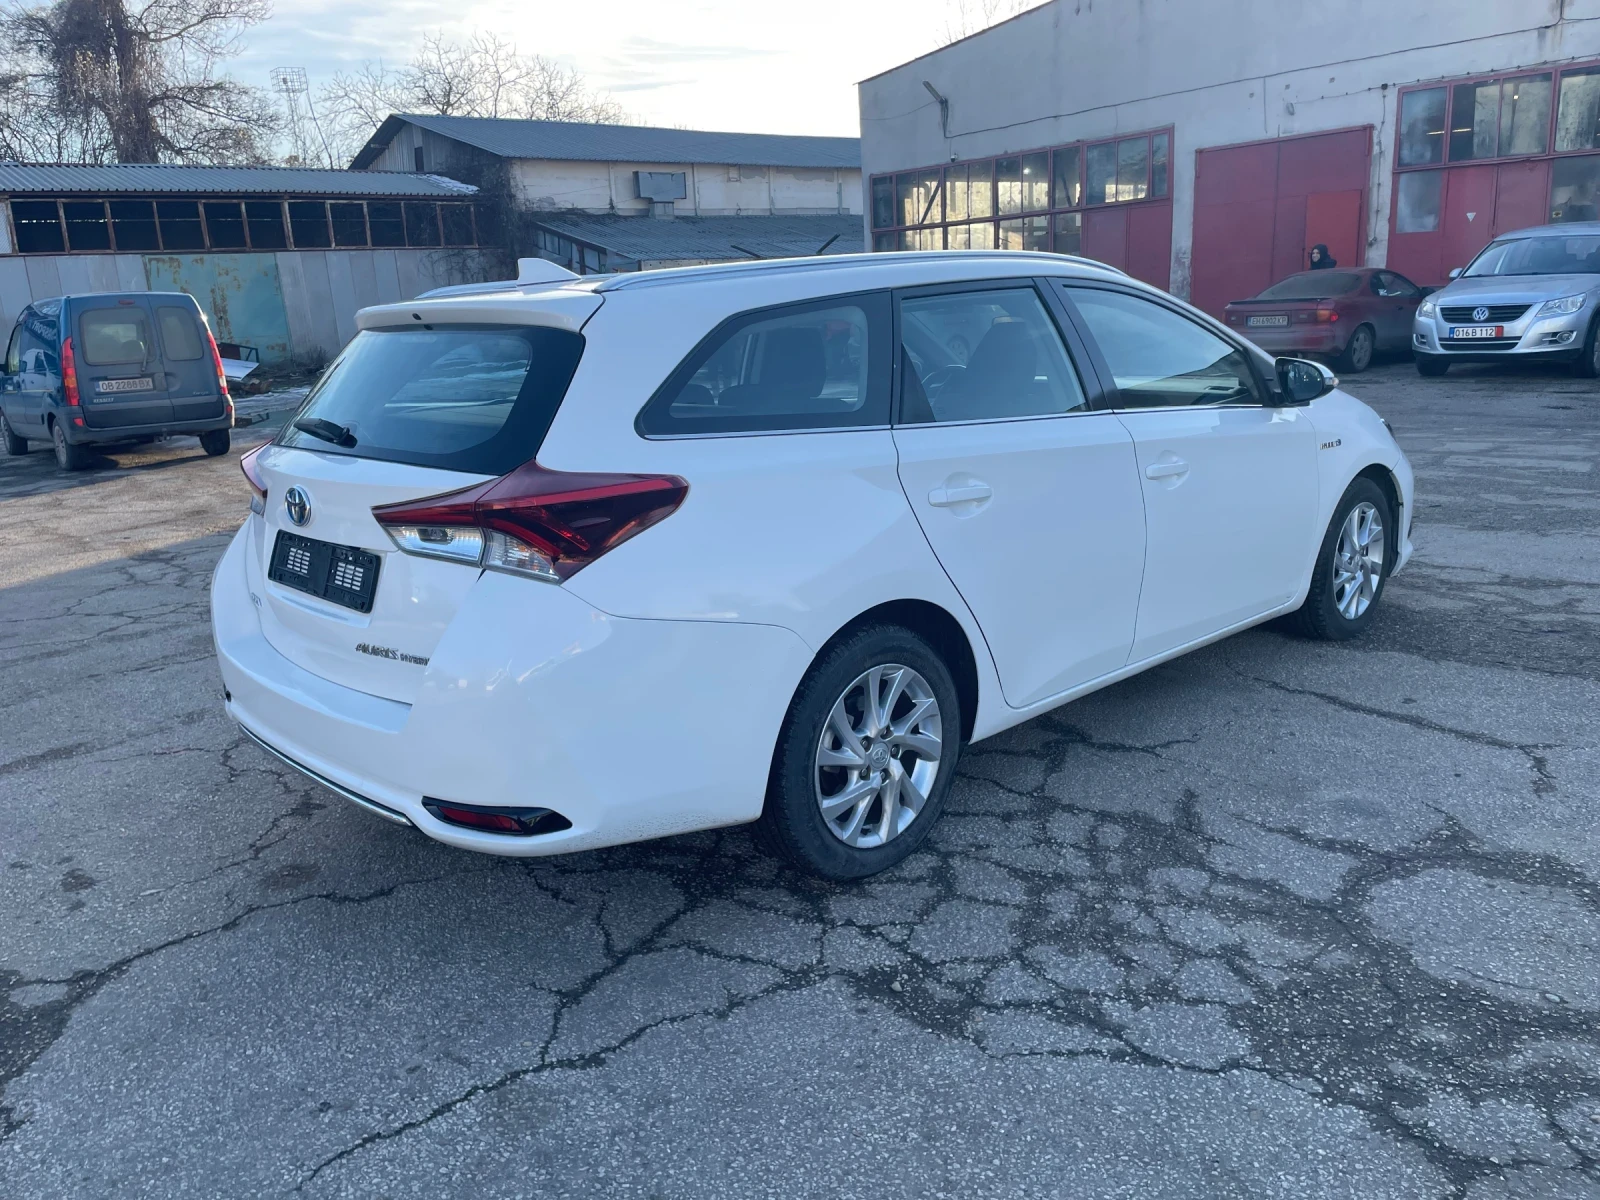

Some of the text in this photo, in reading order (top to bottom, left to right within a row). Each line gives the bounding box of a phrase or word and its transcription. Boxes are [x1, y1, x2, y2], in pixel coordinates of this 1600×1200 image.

[1455, 328, 1494, 337] 016 B 112
